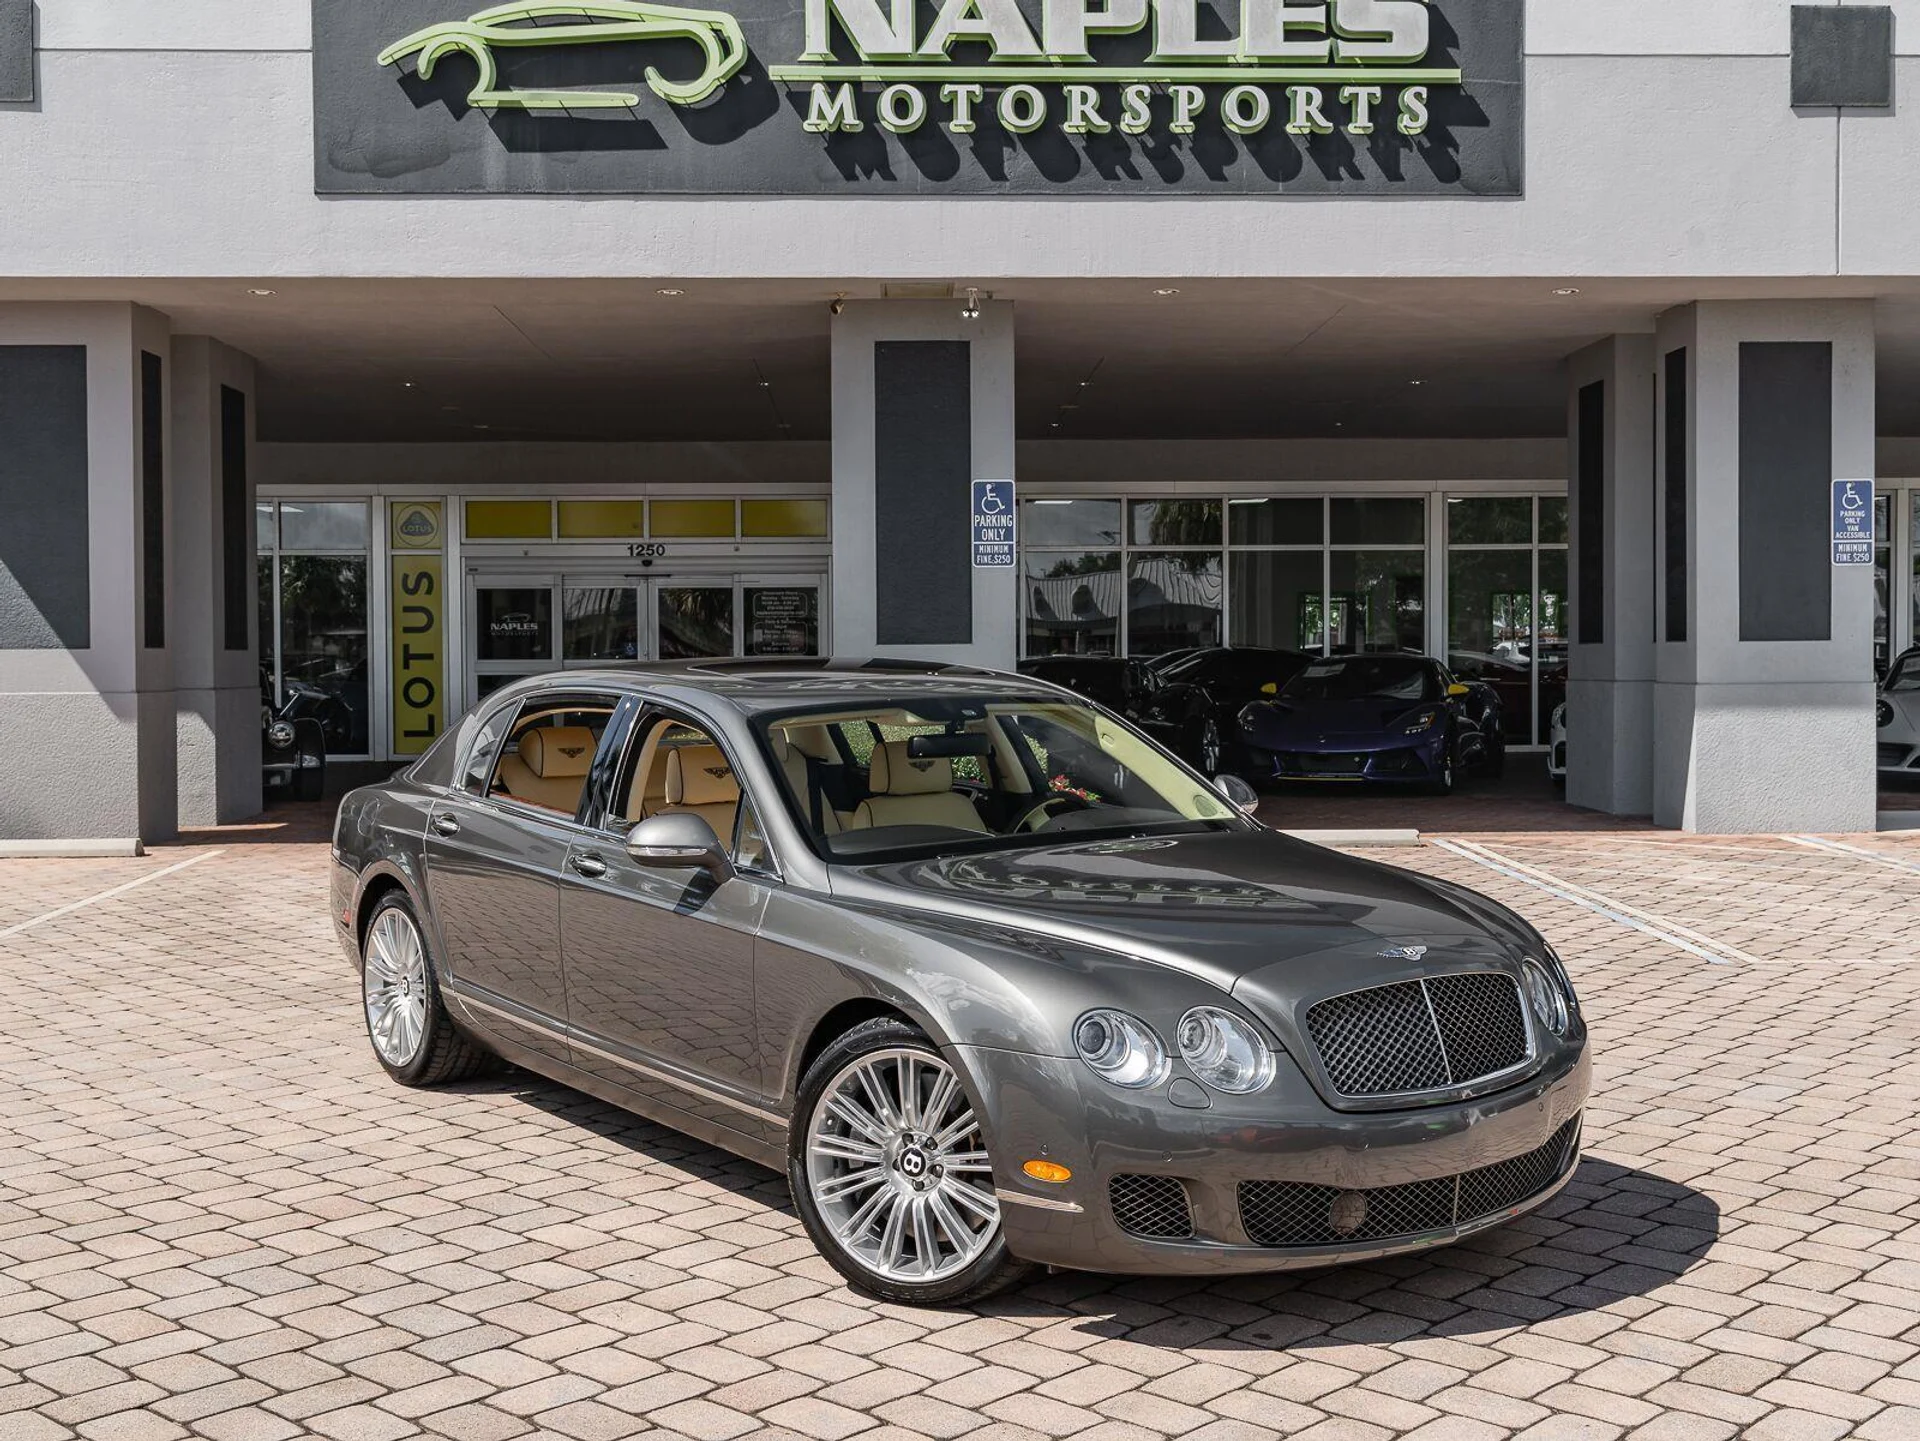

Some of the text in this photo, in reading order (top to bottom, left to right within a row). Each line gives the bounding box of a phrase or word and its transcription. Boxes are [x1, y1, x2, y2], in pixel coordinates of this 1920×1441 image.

[797, 0, 1430, 63] NAPLES
[803, 83, 1430, 134] MOTORSPORTS
[974, 514, 1013, 527] PARKING
[981, 529, 1006, 541] ONLY
[627, 543, 666, 557] 1250
[978, 544, 1009, 553] MINIMUM
[1838, 543, 1868, 552] MINIMUM
[976, 554, 1011, 564] FINE $250
[1835, 553, 1870, 563] FINE $250
[490, 622, 539, 630] NAPLES
[402, 571, 435, 738] LOTUS
[904, 1151, 922, 1174] B
